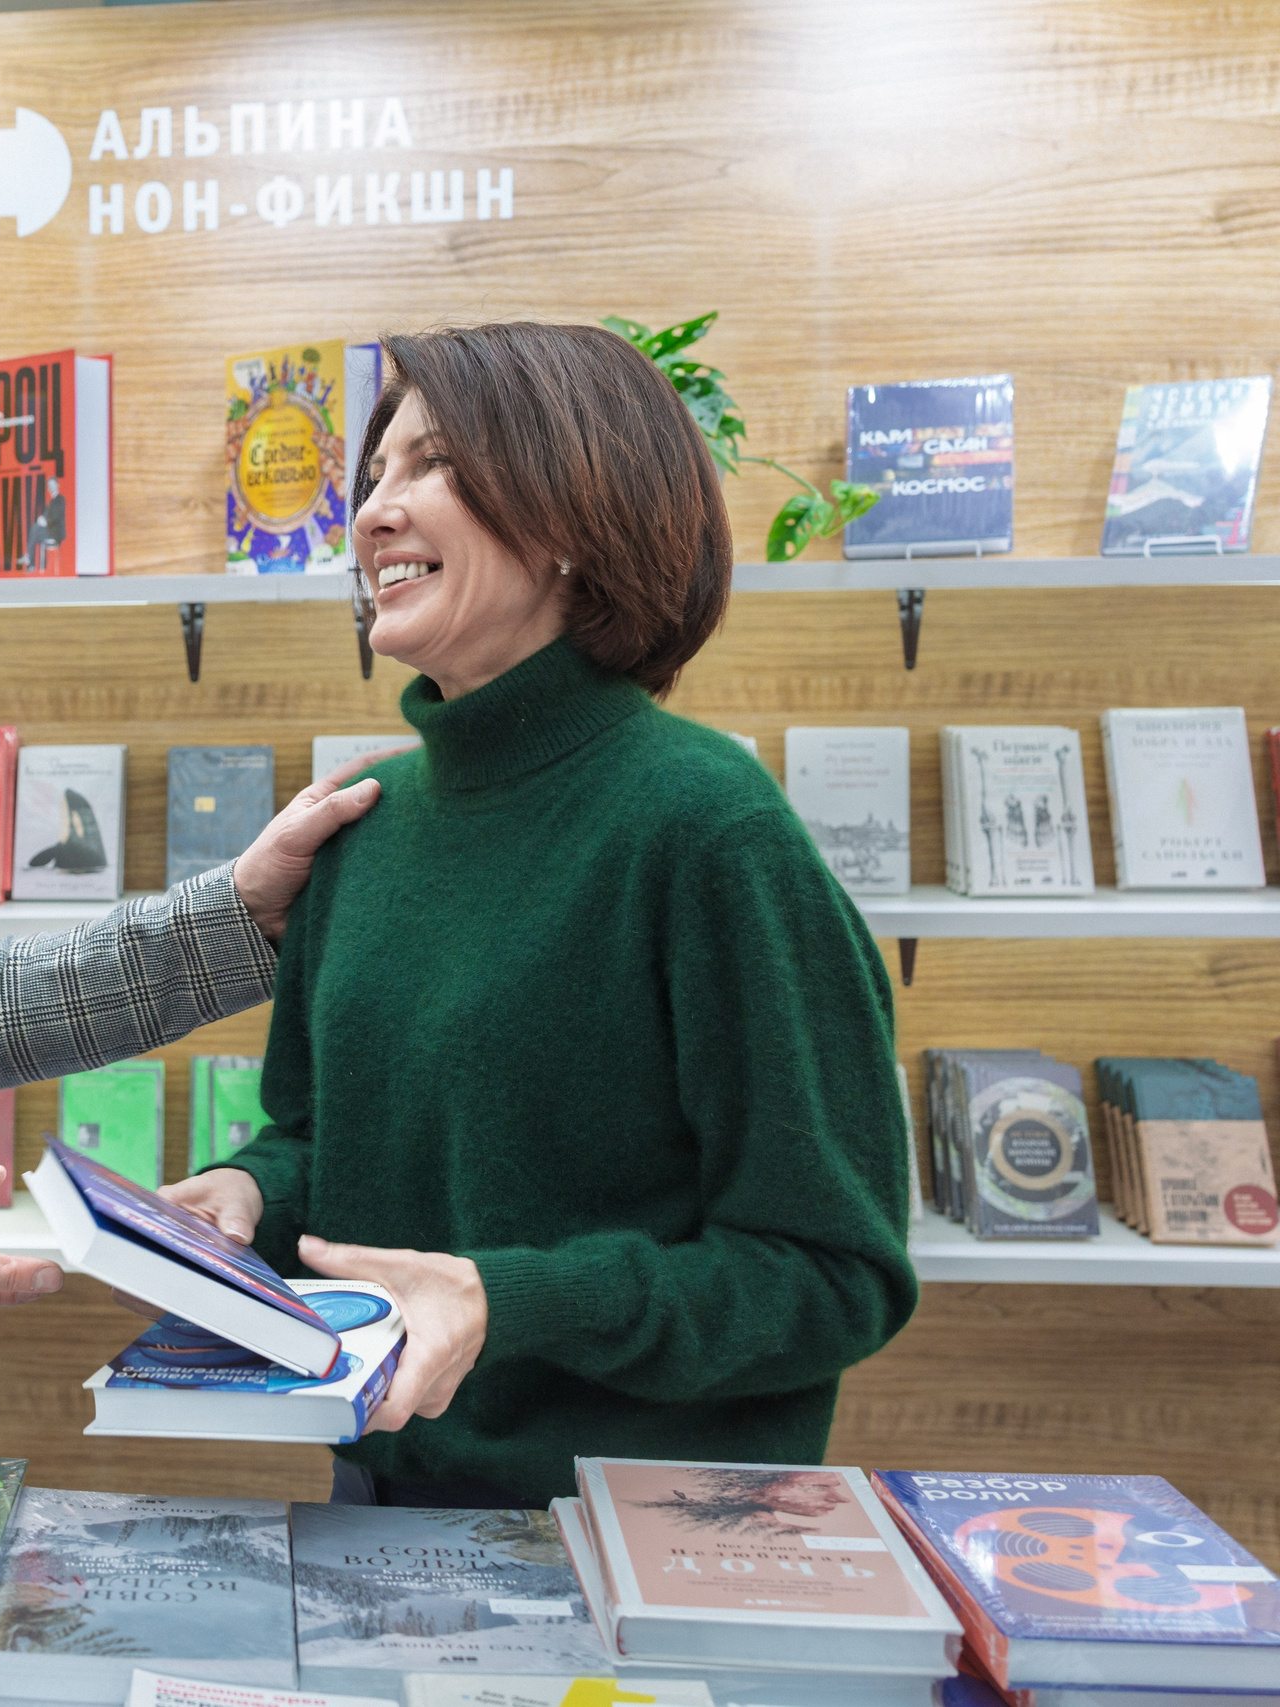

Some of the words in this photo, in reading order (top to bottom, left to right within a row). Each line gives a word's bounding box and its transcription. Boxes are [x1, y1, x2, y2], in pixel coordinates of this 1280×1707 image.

[89, 97, 413, 161] АЛЬПИНА
[89, 167, 515, 238] НОН-ФИКШН
[892, 476, 986, 497] КОСМОС
[115, 1371, 193, 1380] нашего
[122, 1365, 301, 1377] ессознательного
[203, 1373, 267, 1384] Тайны
[911, 1475, 1067, 1493] Разбор
[922, 1489, 1031, 1502] роли
[379, 1546, 487, 1558] СОВЫ
[670, 1548, 852, 1562] Нелюбимая
[343, 1555, 392, 1566] ВО
[408, 1559, 532, 1572] ЛЬДАХ
[361, 1574, 425, 1582] САМОГО
[187, 1580, 239, 1592] ВО
[83, 1590, 198, 1604] СОВЫ
[376, 1642, 481, 1650] ДЖОНАТАН
